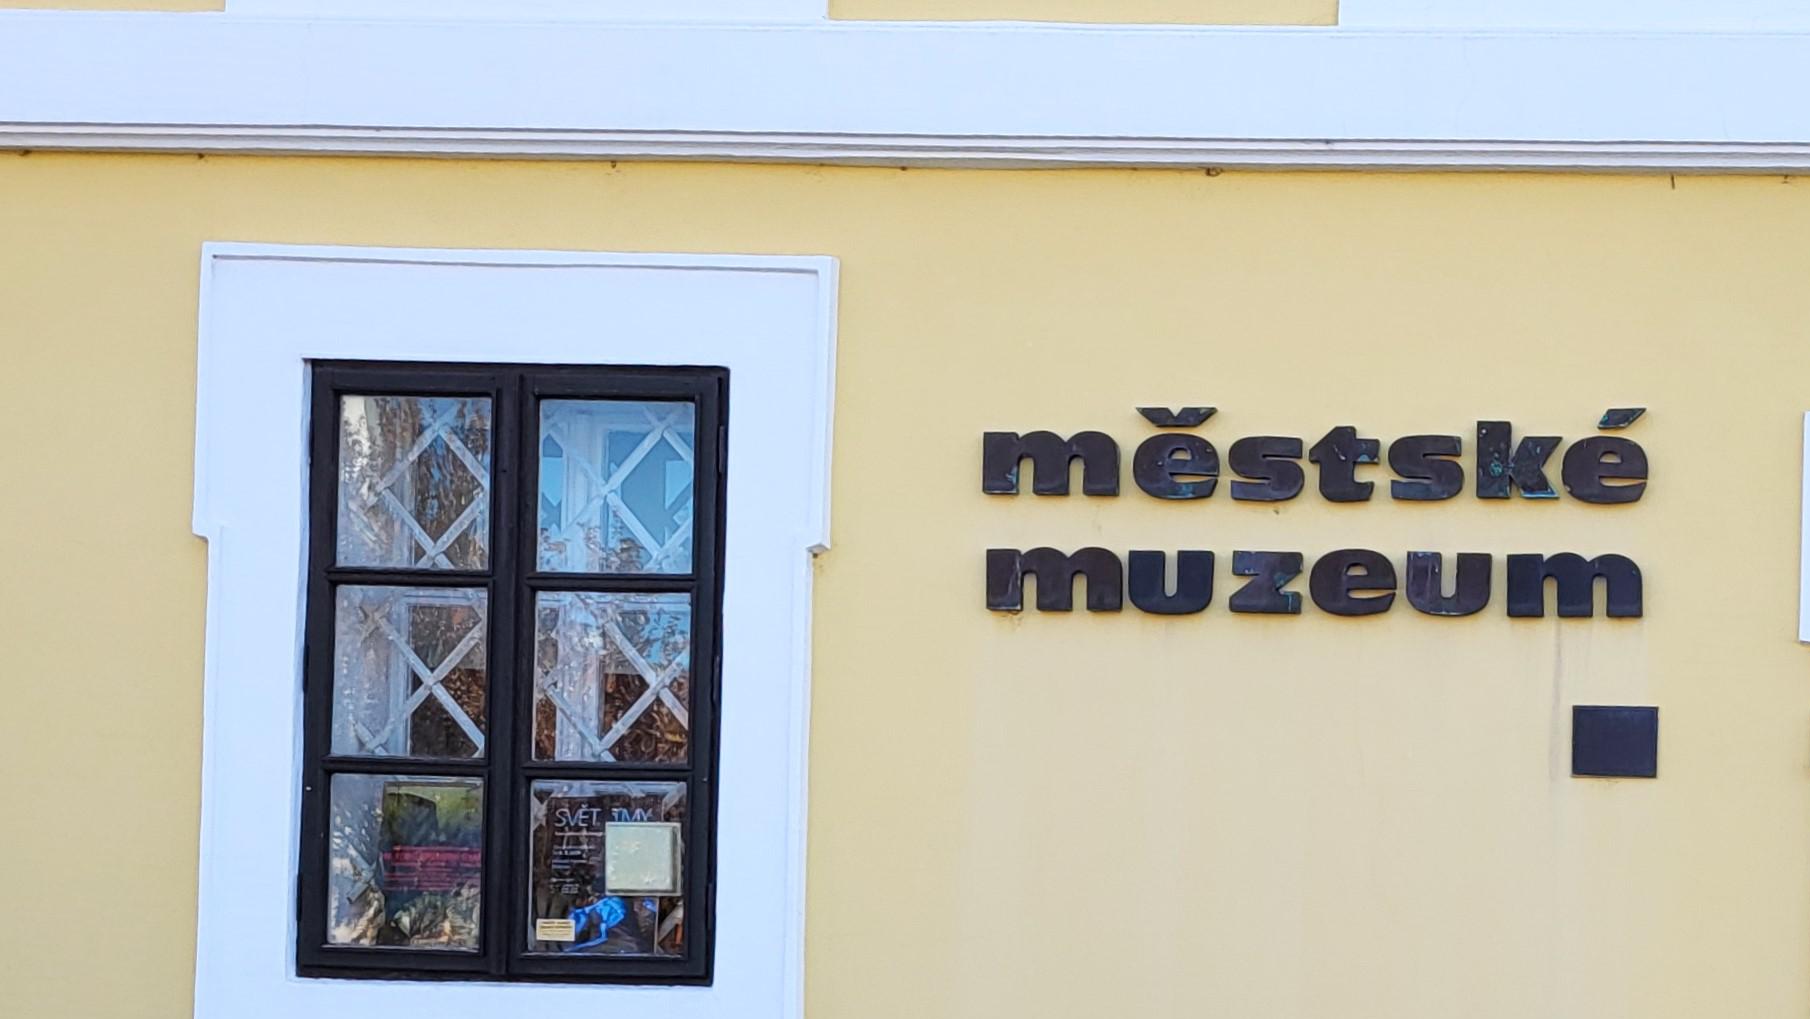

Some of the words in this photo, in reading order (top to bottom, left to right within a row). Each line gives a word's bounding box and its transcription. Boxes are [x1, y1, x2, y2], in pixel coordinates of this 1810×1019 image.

[982, 406, 1649, 504] městské
[986, 546, 1643, 618] muzeum
[554, 803, 602, 827] SVĚT
[611, 807, 653, 821] TMY
